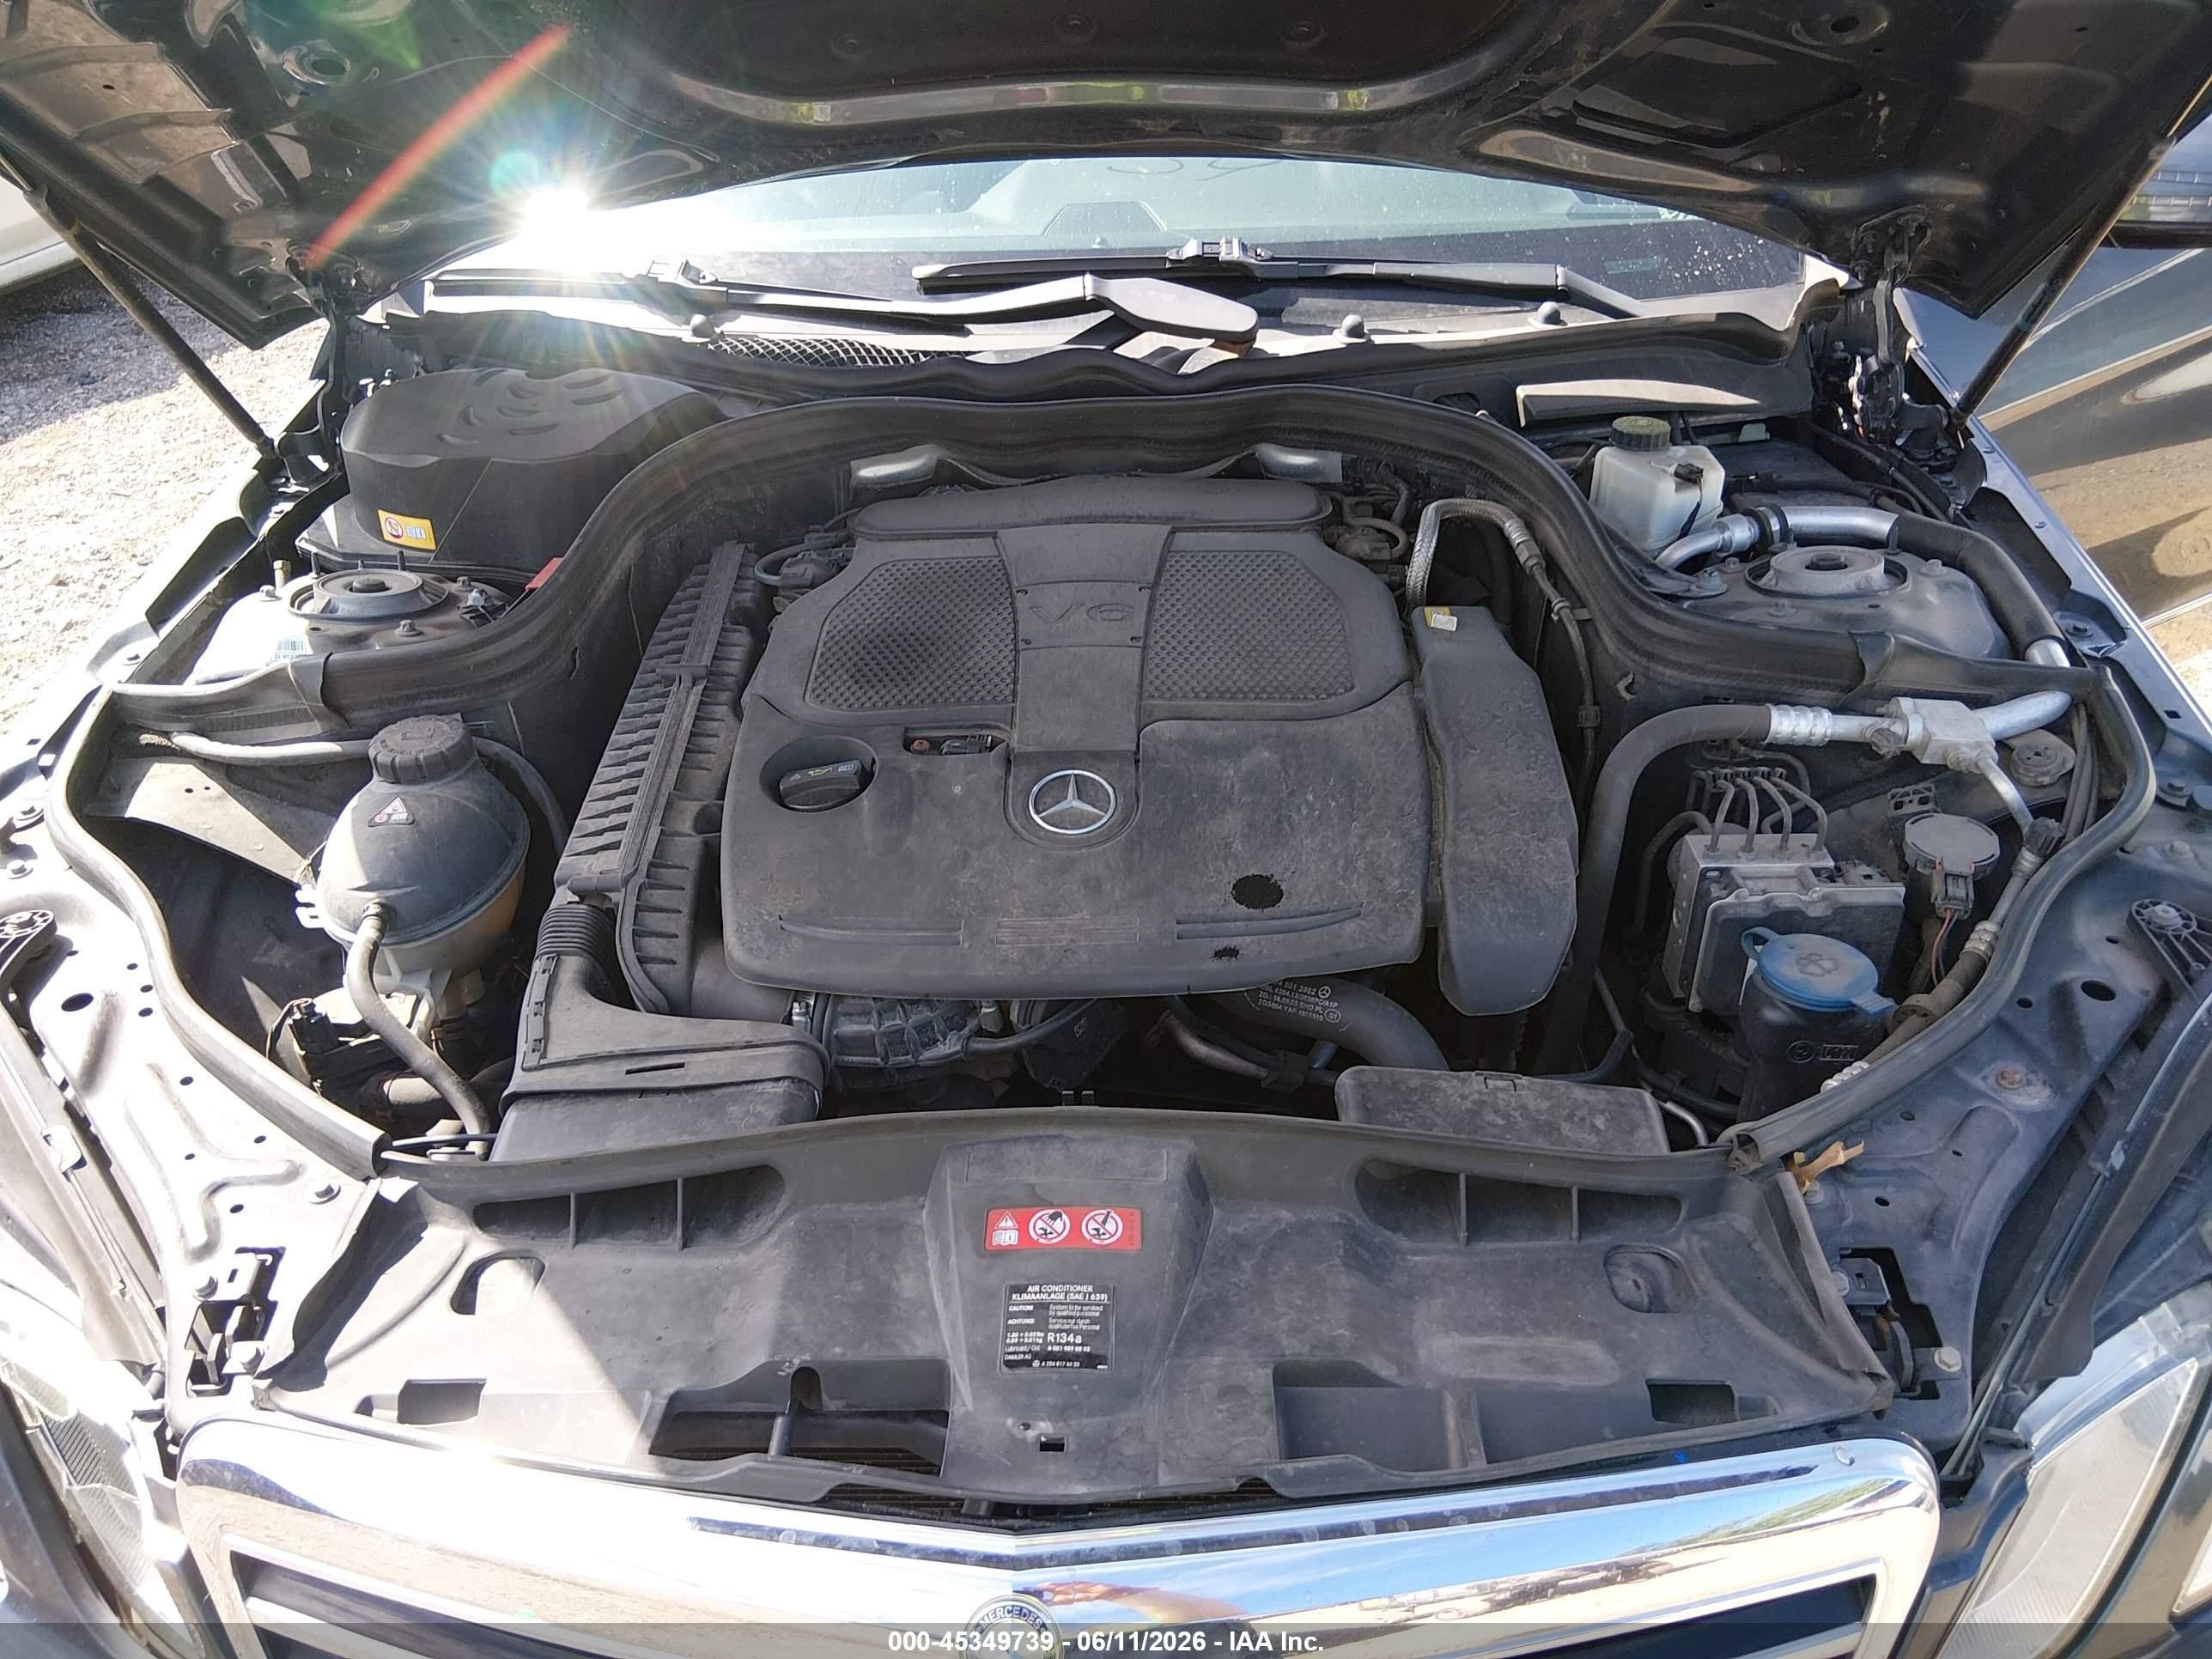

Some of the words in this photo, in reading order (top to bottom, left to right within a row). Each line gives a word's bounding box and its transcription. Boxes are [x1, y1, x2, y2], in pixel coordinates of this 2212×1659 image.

[1029, 603, 1134, 623] V6
[1091, 1293, 1108, 1303] 639)
[981, 1605, 1043, 1629] MERCEDES
